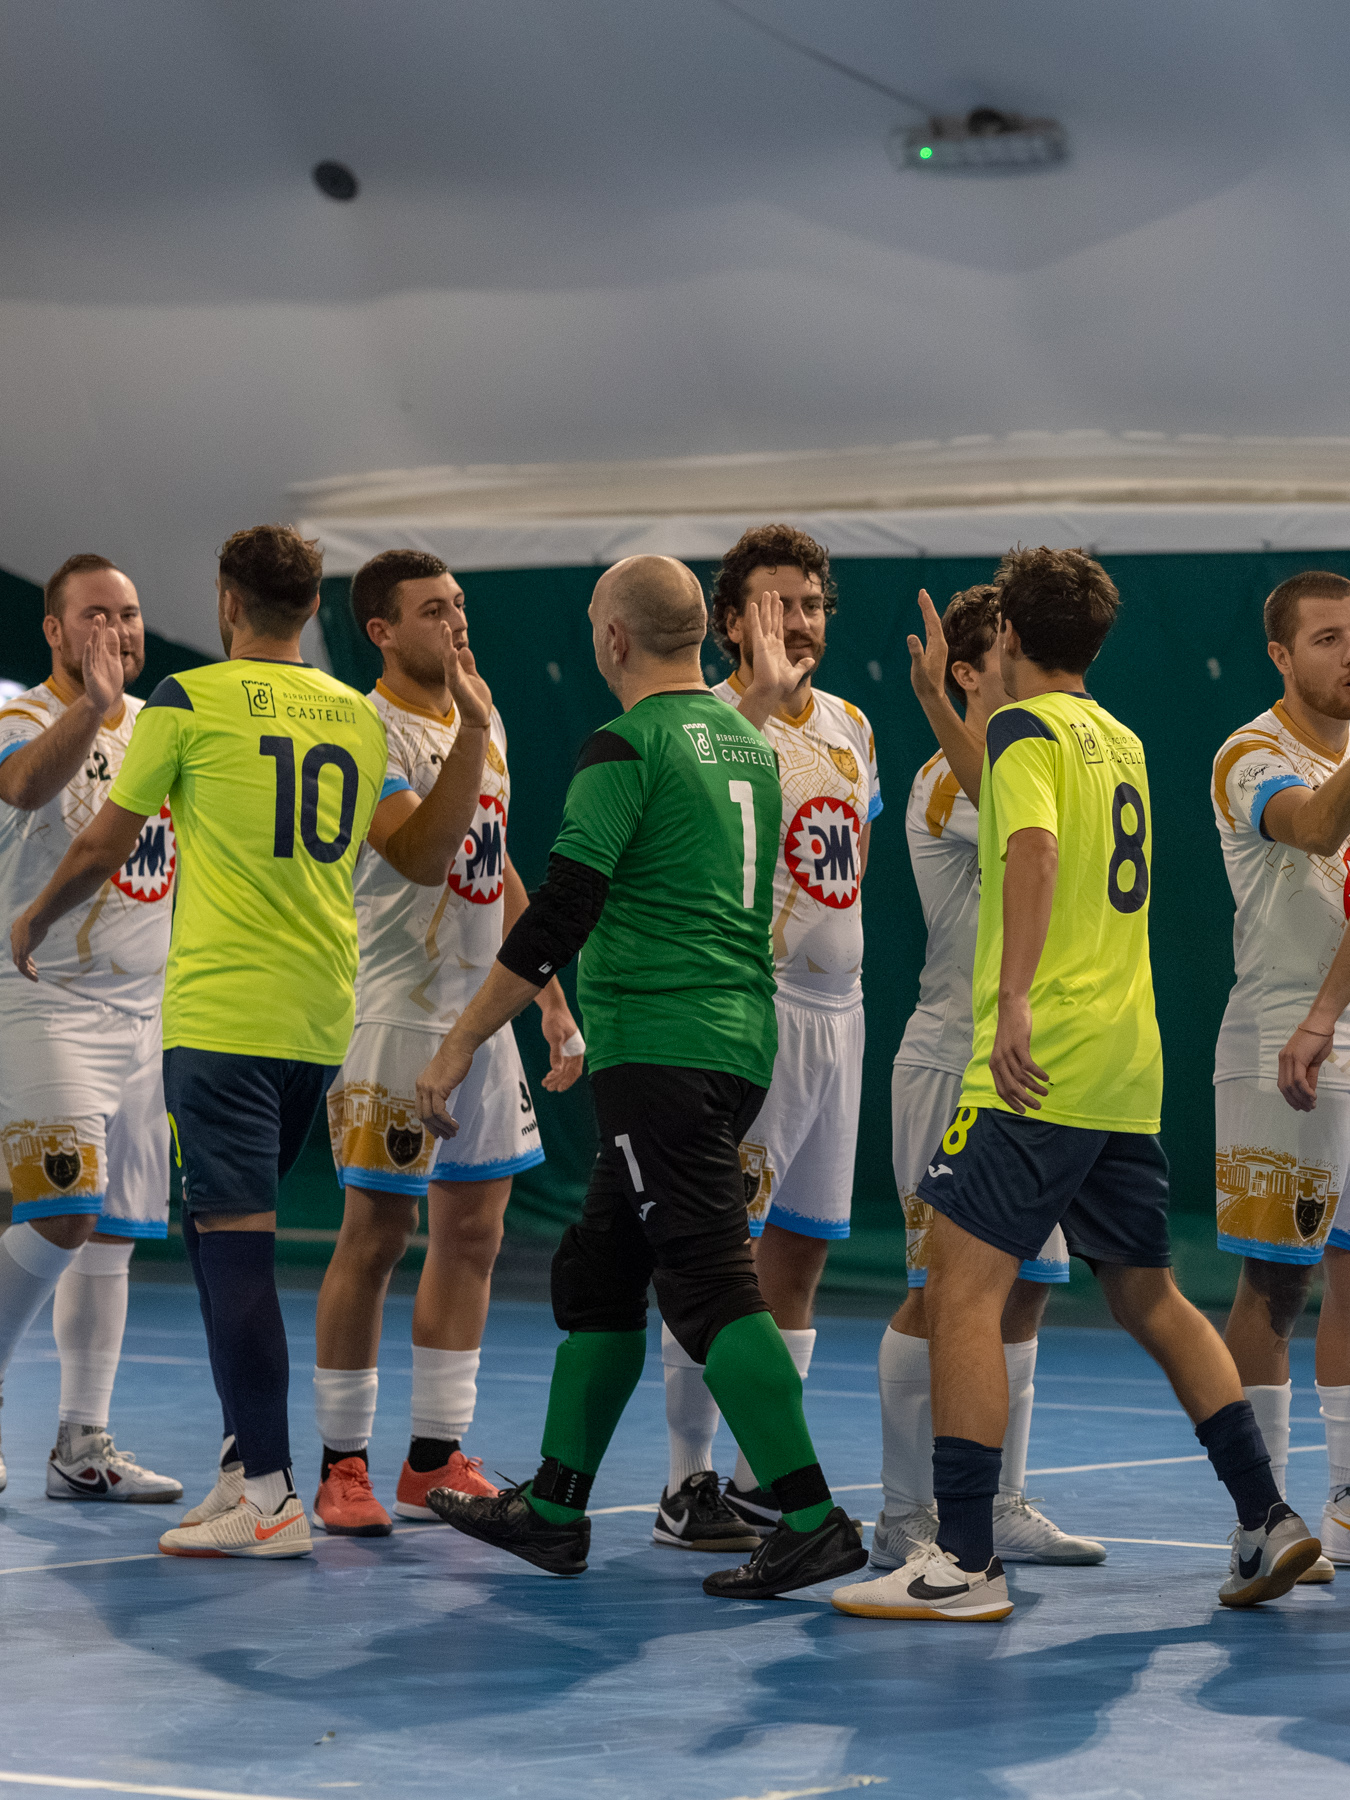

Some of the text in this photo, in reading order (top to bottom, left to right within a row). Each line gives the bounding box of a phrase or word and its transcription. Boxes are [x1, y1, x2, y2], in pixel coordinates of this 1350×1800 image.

[287, 706, 356, 724] CASTELLI
[715, 733, 756, 745] BIRRIFICIO
[721, 749, 775, 768] CASTELLI
[259, 735, 359, 864] 10
[729, 780, 757, 908] 1
[808, 825, 856, 881] PM
[1107, 782, 1148, 914] 8
[942, 1107, 978, 1156] 8
[615, 1134, 645, 1192] 1
